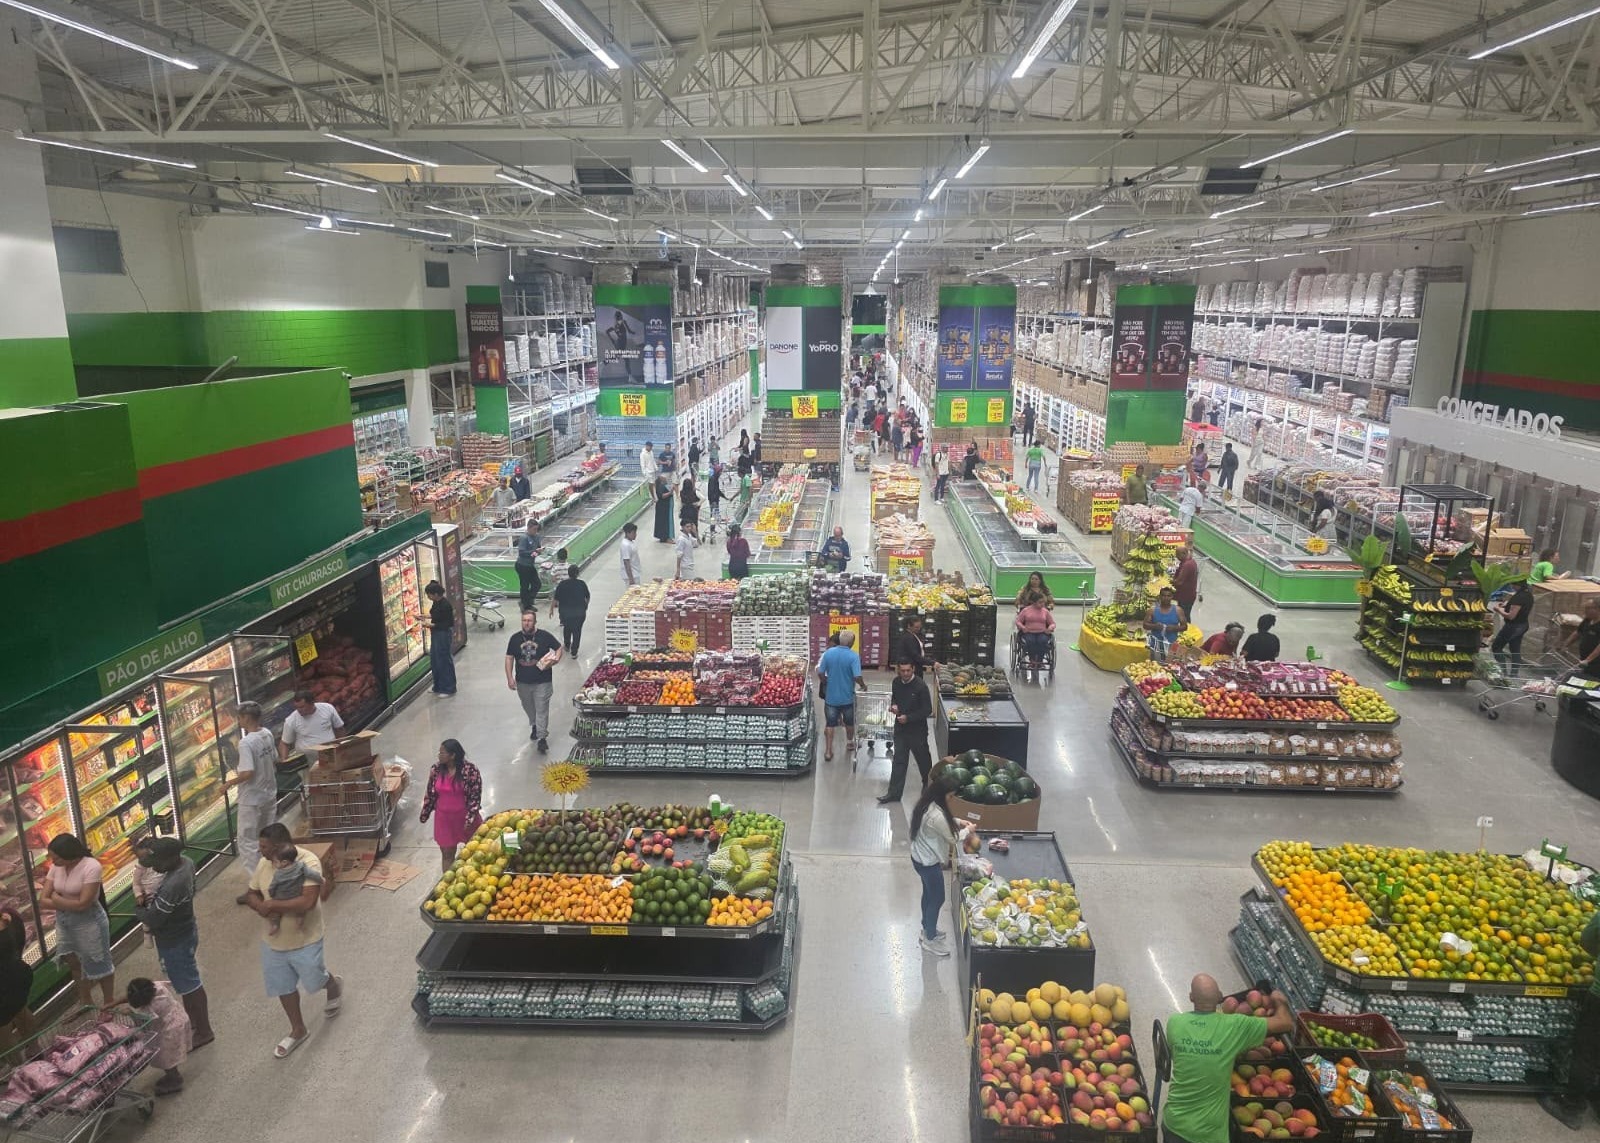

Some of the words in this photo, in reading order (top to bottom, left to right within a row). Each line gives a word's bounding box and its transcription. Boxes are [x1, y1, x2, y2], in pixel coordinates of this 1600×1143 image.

[808, 344, 839, 352] YoPRO
[1437, 395, 1564, 439] CONGELADOS
[275, 584, 291, 600] KIT
[292, 557, 344, 591] CHURRASCO
[105, 659, 137, 688] PÃO
[140, 652, 161, 671] DE
[162, 630, 199, 661] ALHO
[1181, 1036, 1192, 1045] TÔ
[1192, 1039, 1213, 1048] AQUI
